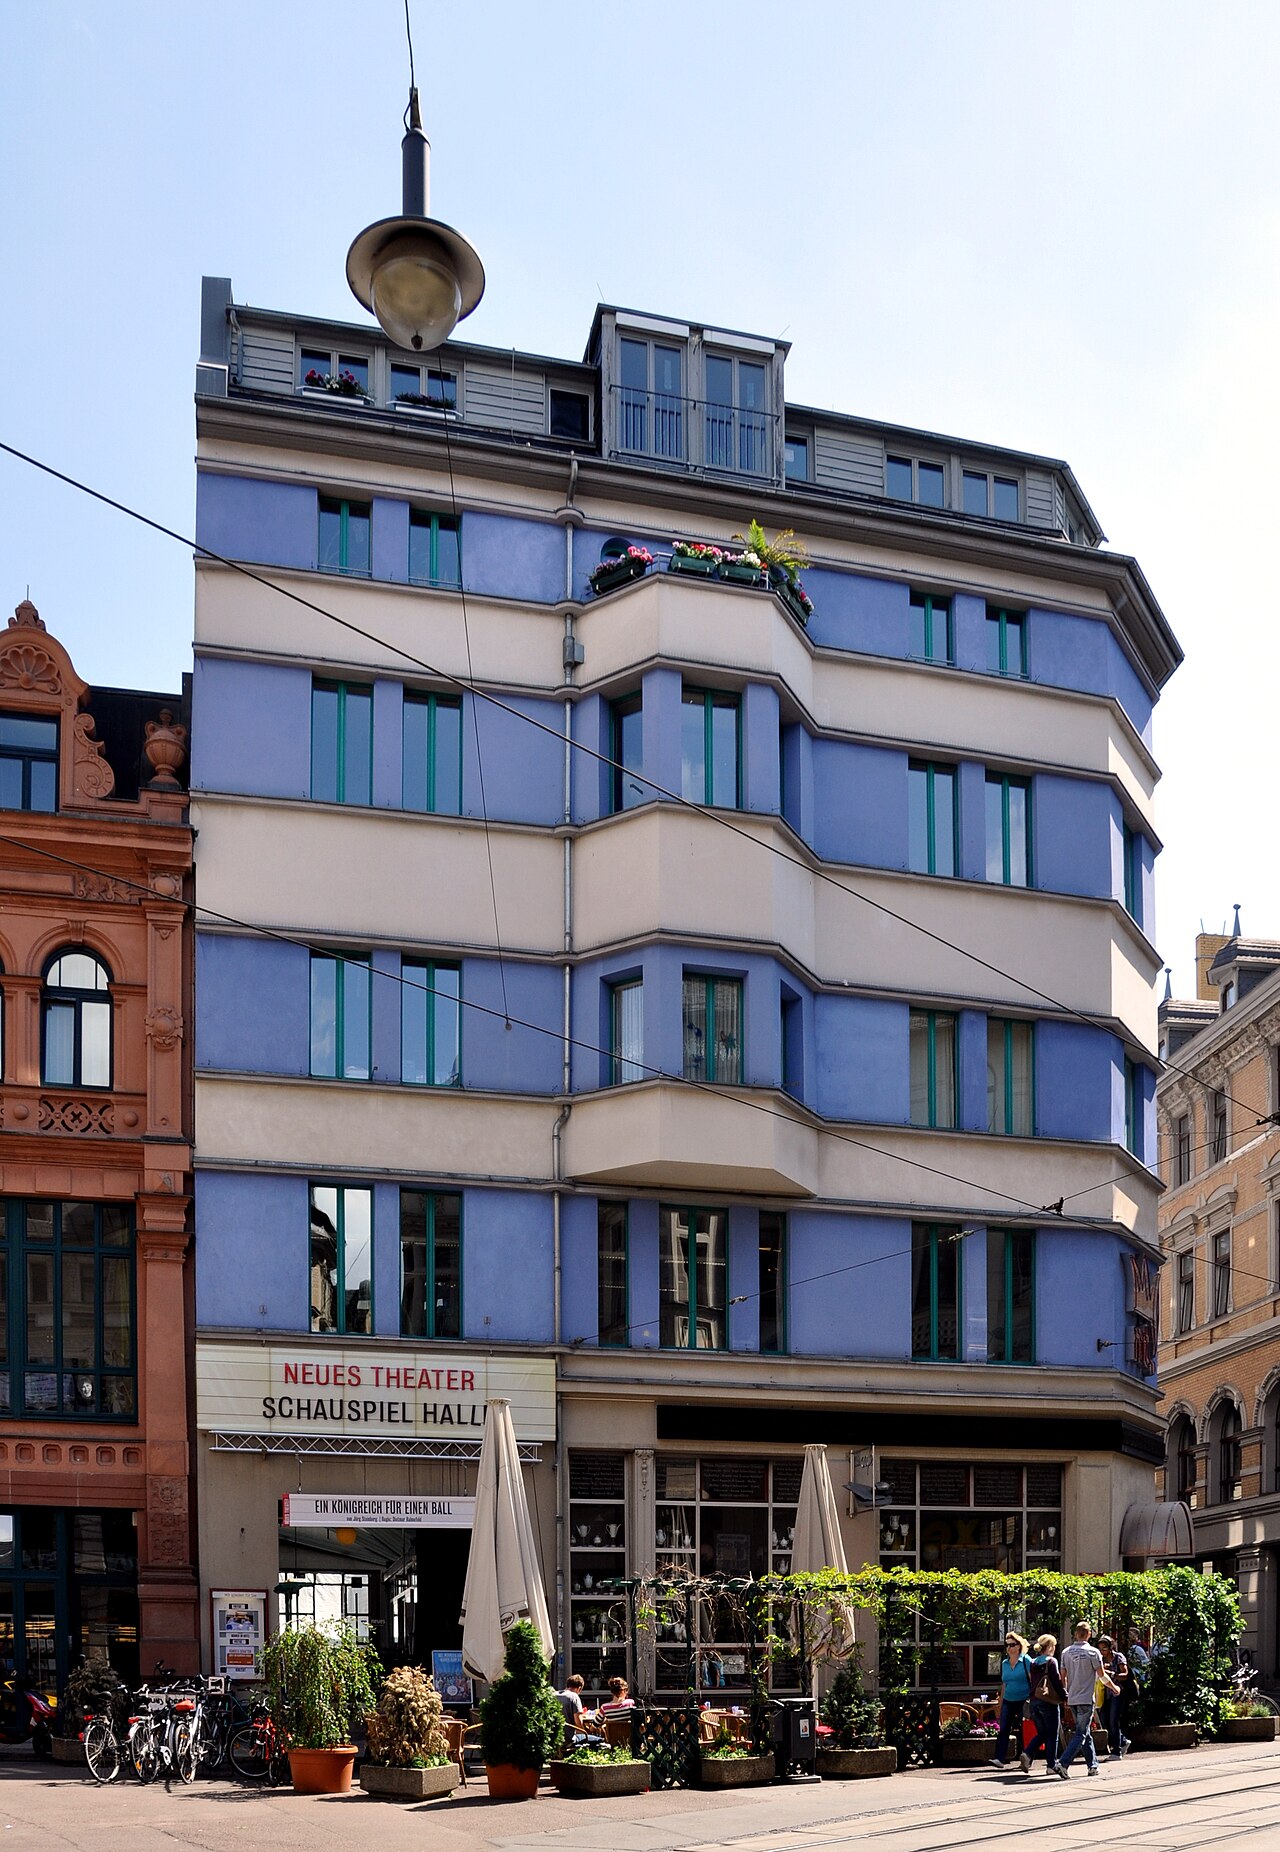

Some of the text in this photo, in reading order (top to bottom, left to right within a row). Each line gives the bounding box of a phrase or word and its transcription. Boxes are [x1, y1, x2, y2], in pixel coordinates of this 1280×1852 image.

[284, 1362, 475, 1391] NEUES THEATER
[262, 1397, 413, 1424] SCHAUSPIEL
[315, 1499, 453, 1515] EIN KÖNIGREICH FÜR EINEN BALL
